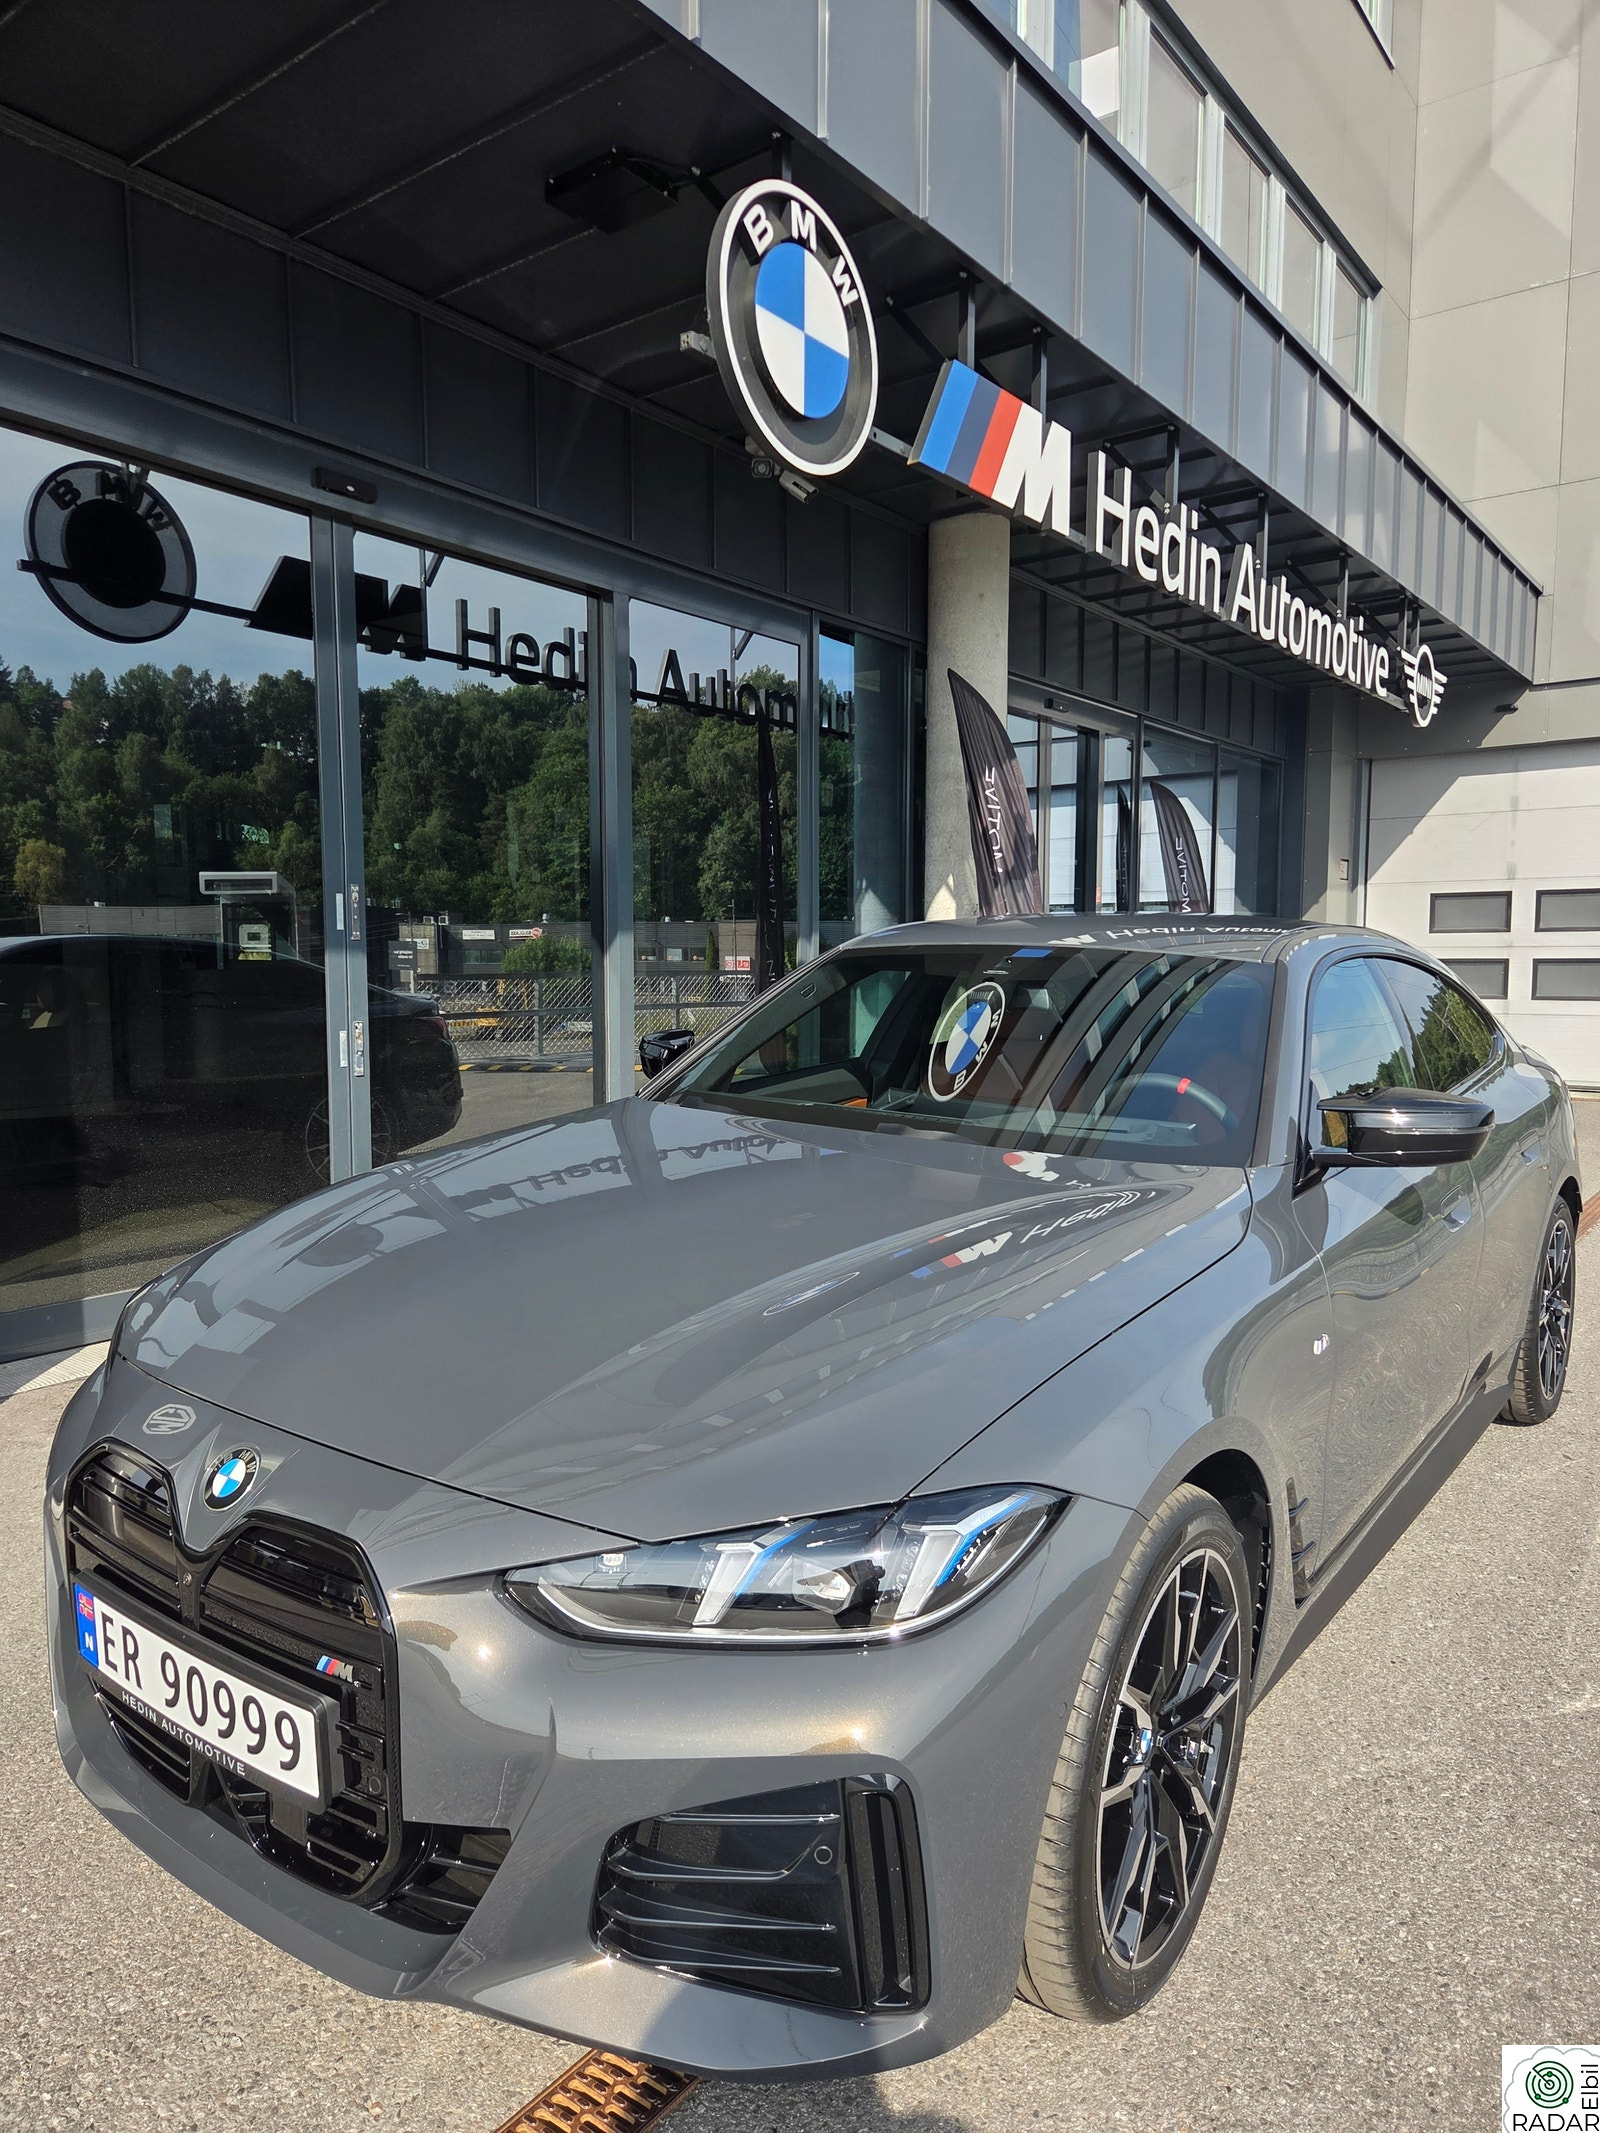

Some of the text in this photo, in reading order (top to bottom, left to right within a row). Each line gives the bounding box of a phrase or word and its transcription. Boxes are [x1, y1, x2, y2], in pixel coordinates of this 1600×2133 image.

[743, 200, 860, 307] BMW
[1089, 451, 1221, 614] Hedin
[1230, 541, 1391, 698] Automotive
[84, 1631, 94, 1652] N
[101, 1610, 301, 1771] ER 90999
[121, 1690, 245, 1776] HEDIN AUTOMOTIVE
